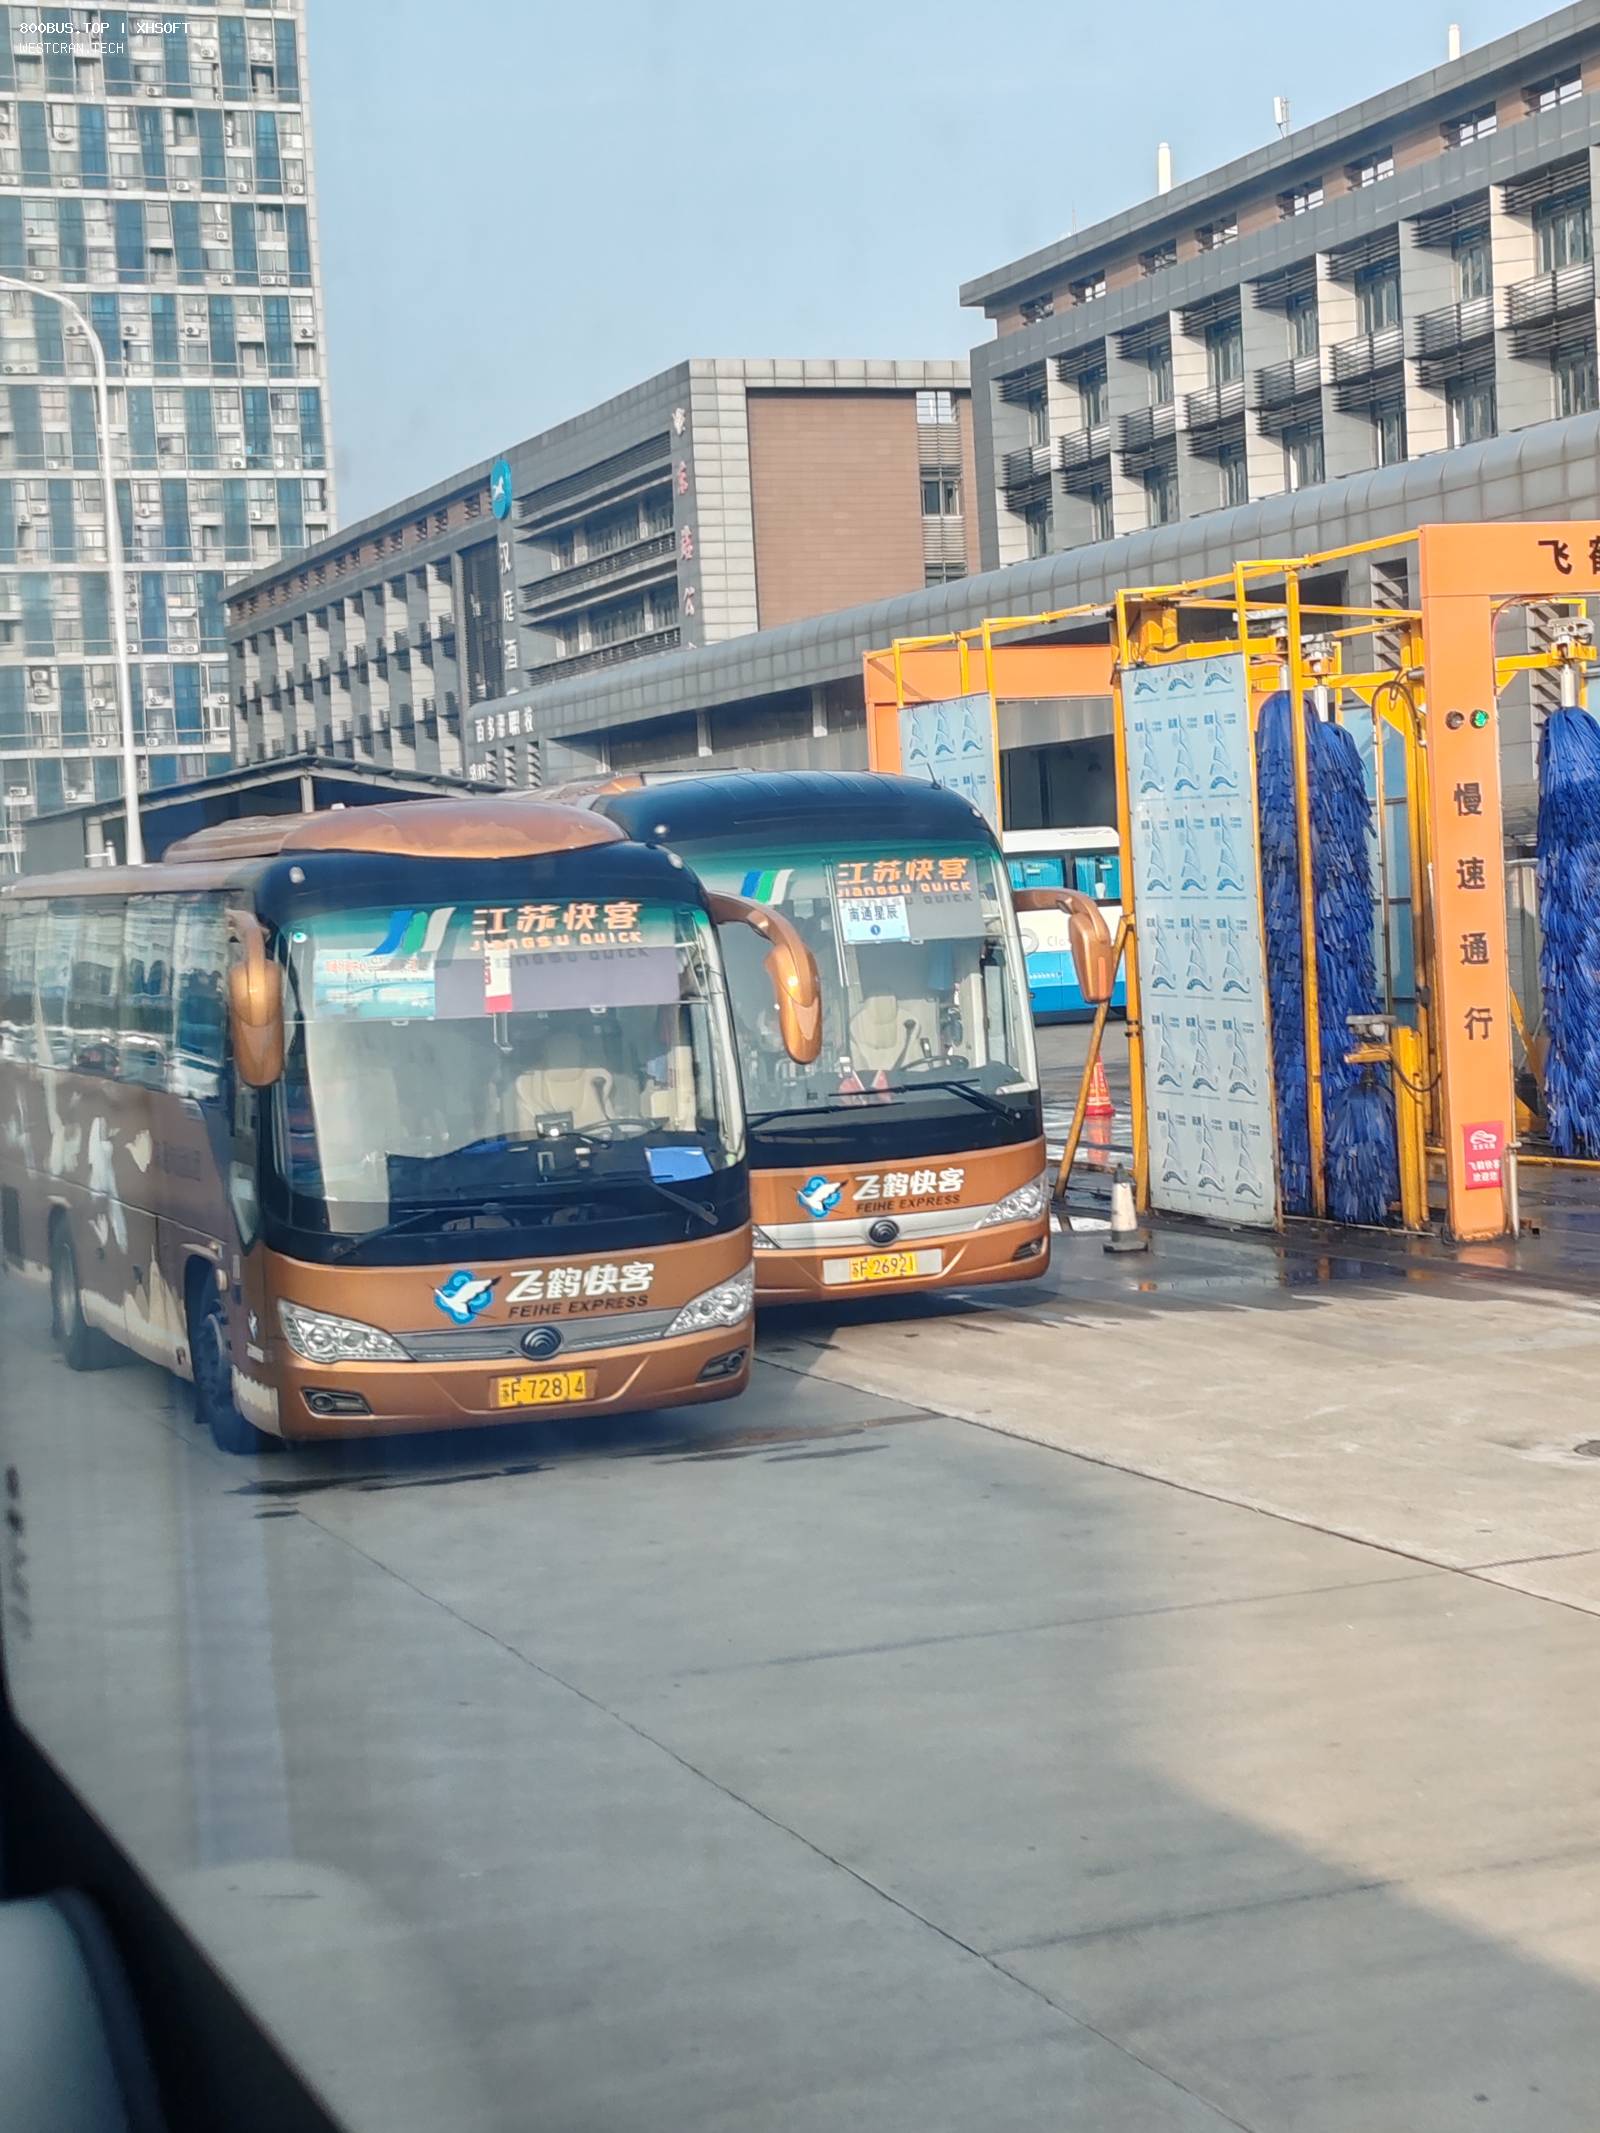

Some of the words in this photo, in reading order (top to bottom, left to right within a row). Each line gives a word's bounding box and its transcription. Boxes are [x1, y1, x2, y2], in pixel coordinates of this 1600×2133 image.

[499, 541, 520, 697] 汉庭酒
[837, 858, 970, 885] 江苏快客
[471, 901, 643, 936] 江苏快客
[1454, 782, 1493, 1040] 慢速通行
[579, 931, 643, 945] QUICK
[853, 1168, 965, 1201] 飞鹤快客
[856, 1200, 895, 1213] FEIHE
[899, 1194, 961, 1209] EXPRESS
[506, 1261, 655, 1302] 飞鹤快客
[508, 1302, 561, 1319] FEIHE
[569, 1295, 649, 1315] EXPRESS
